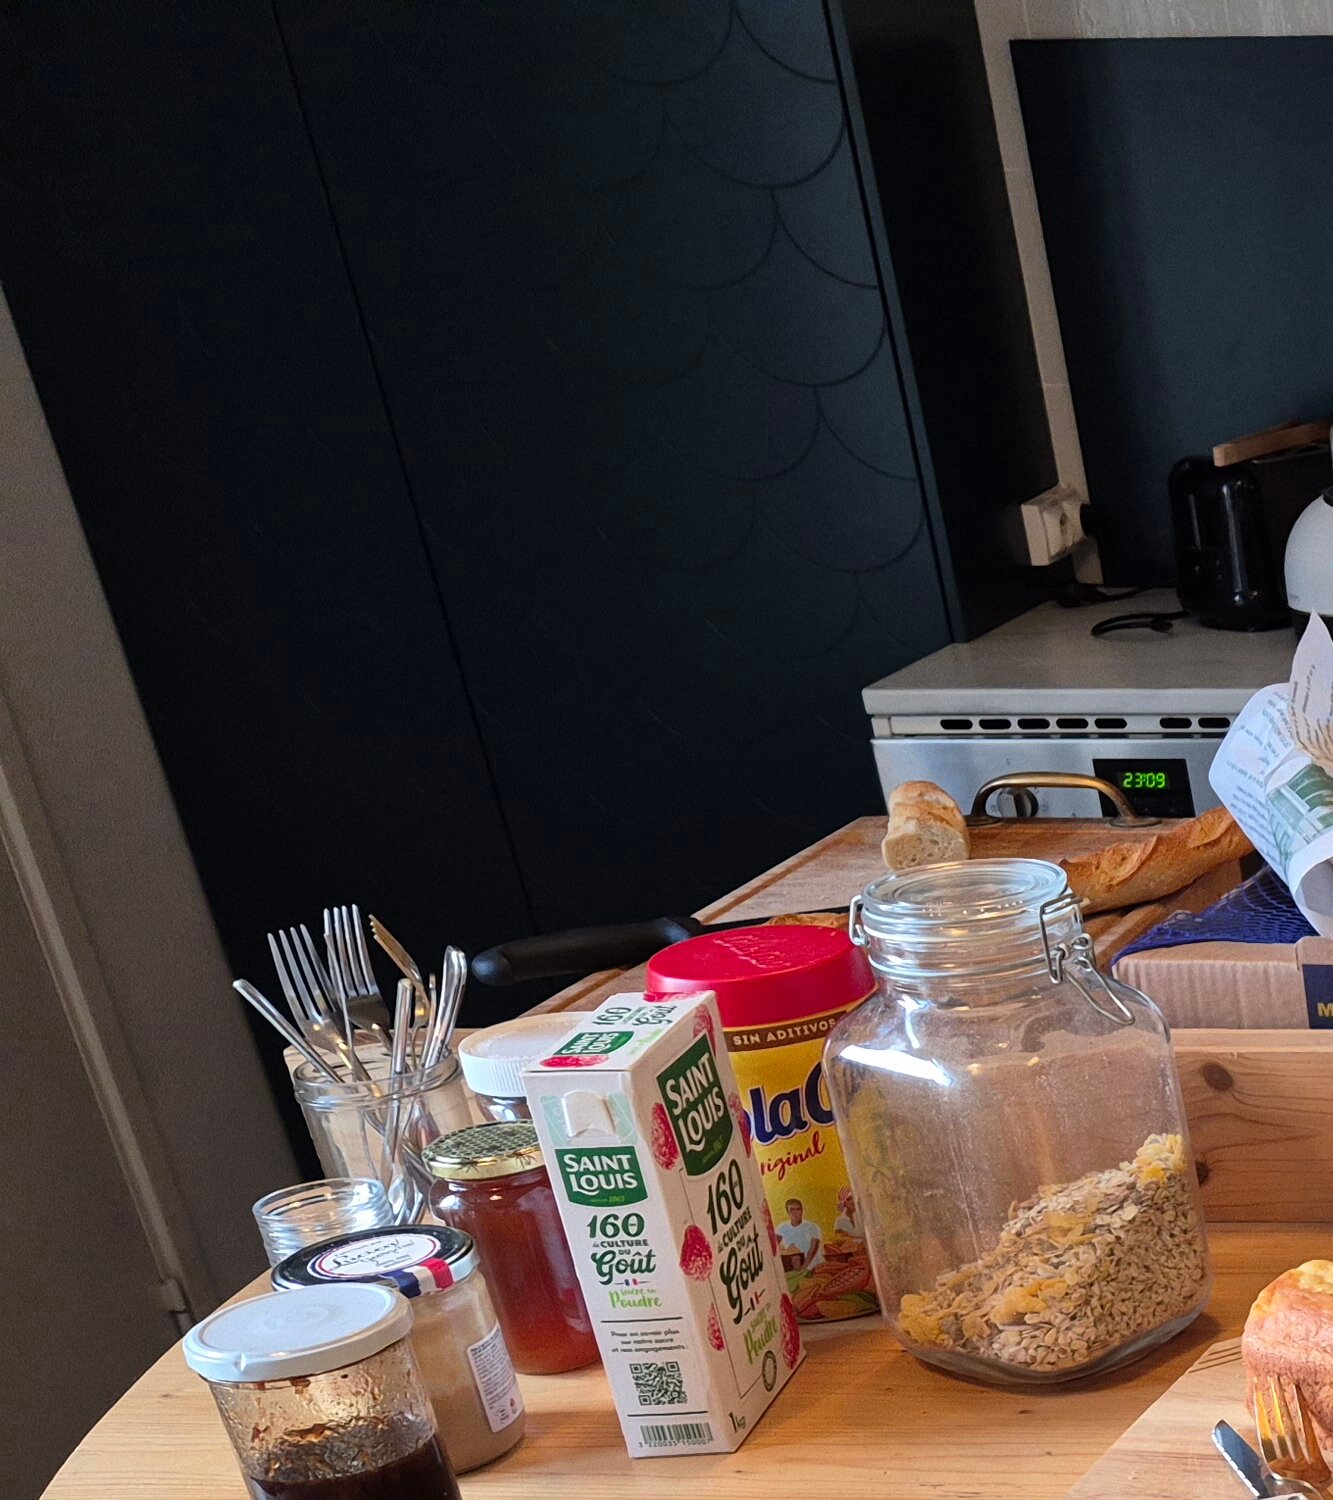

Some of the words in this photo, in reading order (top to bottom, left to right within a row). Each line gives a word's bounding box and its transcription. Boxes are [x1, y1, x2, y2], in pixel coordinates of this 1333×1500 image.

[733, 1033, 761, 1046] SIN
[767, 1018, 835, 1043] ADITIVOS
[665, 1052, 714, 1116] SAINT
[678, 1086, 725, 1153] LOUIS
[563, 1153, 631, 1173] SAINT
[761, 1131, 826, 1180] riginal
[569, 1172, 638, 1196] LOUIS
[707, 1159, 745, 1236] 160
[587, 1212, 645, 1239] 160
[600, 1239, 649, 1248] CULTURE
[722, 1206, 752, 1247] CULTURE
[591, 1249, 657, 1286] Goût
[719, 1221, 763, 1325] Goût
[609, 1291, 662, 1308] Poudre
